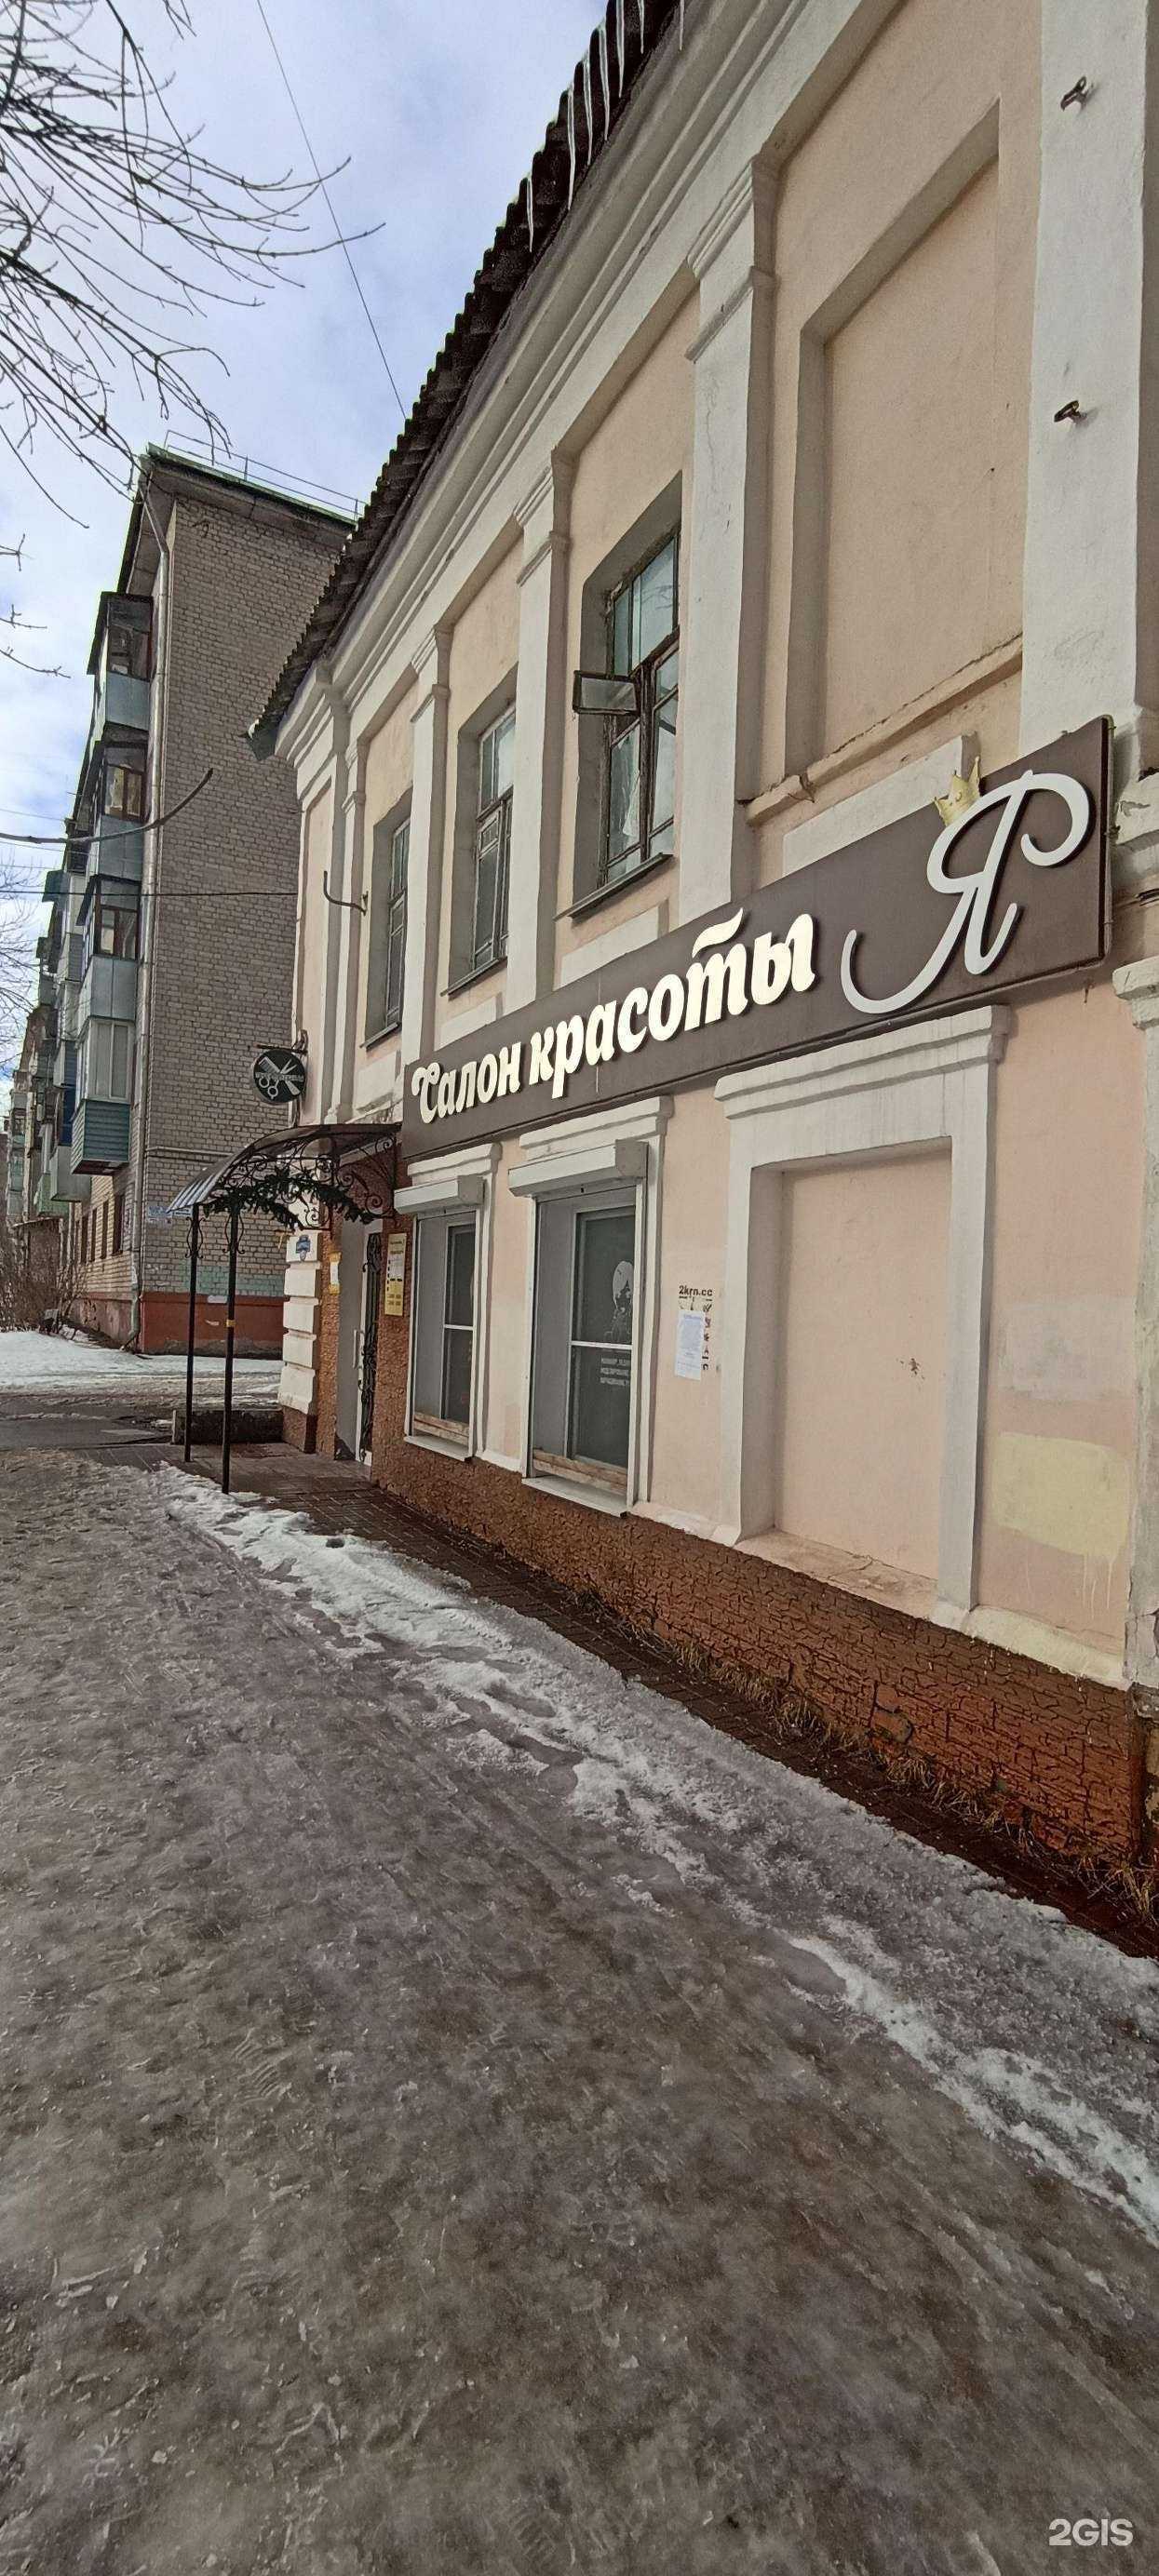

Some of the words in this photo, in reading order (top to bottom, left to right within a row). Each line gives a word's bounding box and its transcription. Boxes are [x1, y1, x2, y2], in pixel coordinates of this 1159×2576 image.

[411, 1041, 521, 1124] Салон
[529, 907, 816, 1099] красоты
[841, 769, 1093, 1015] Я
